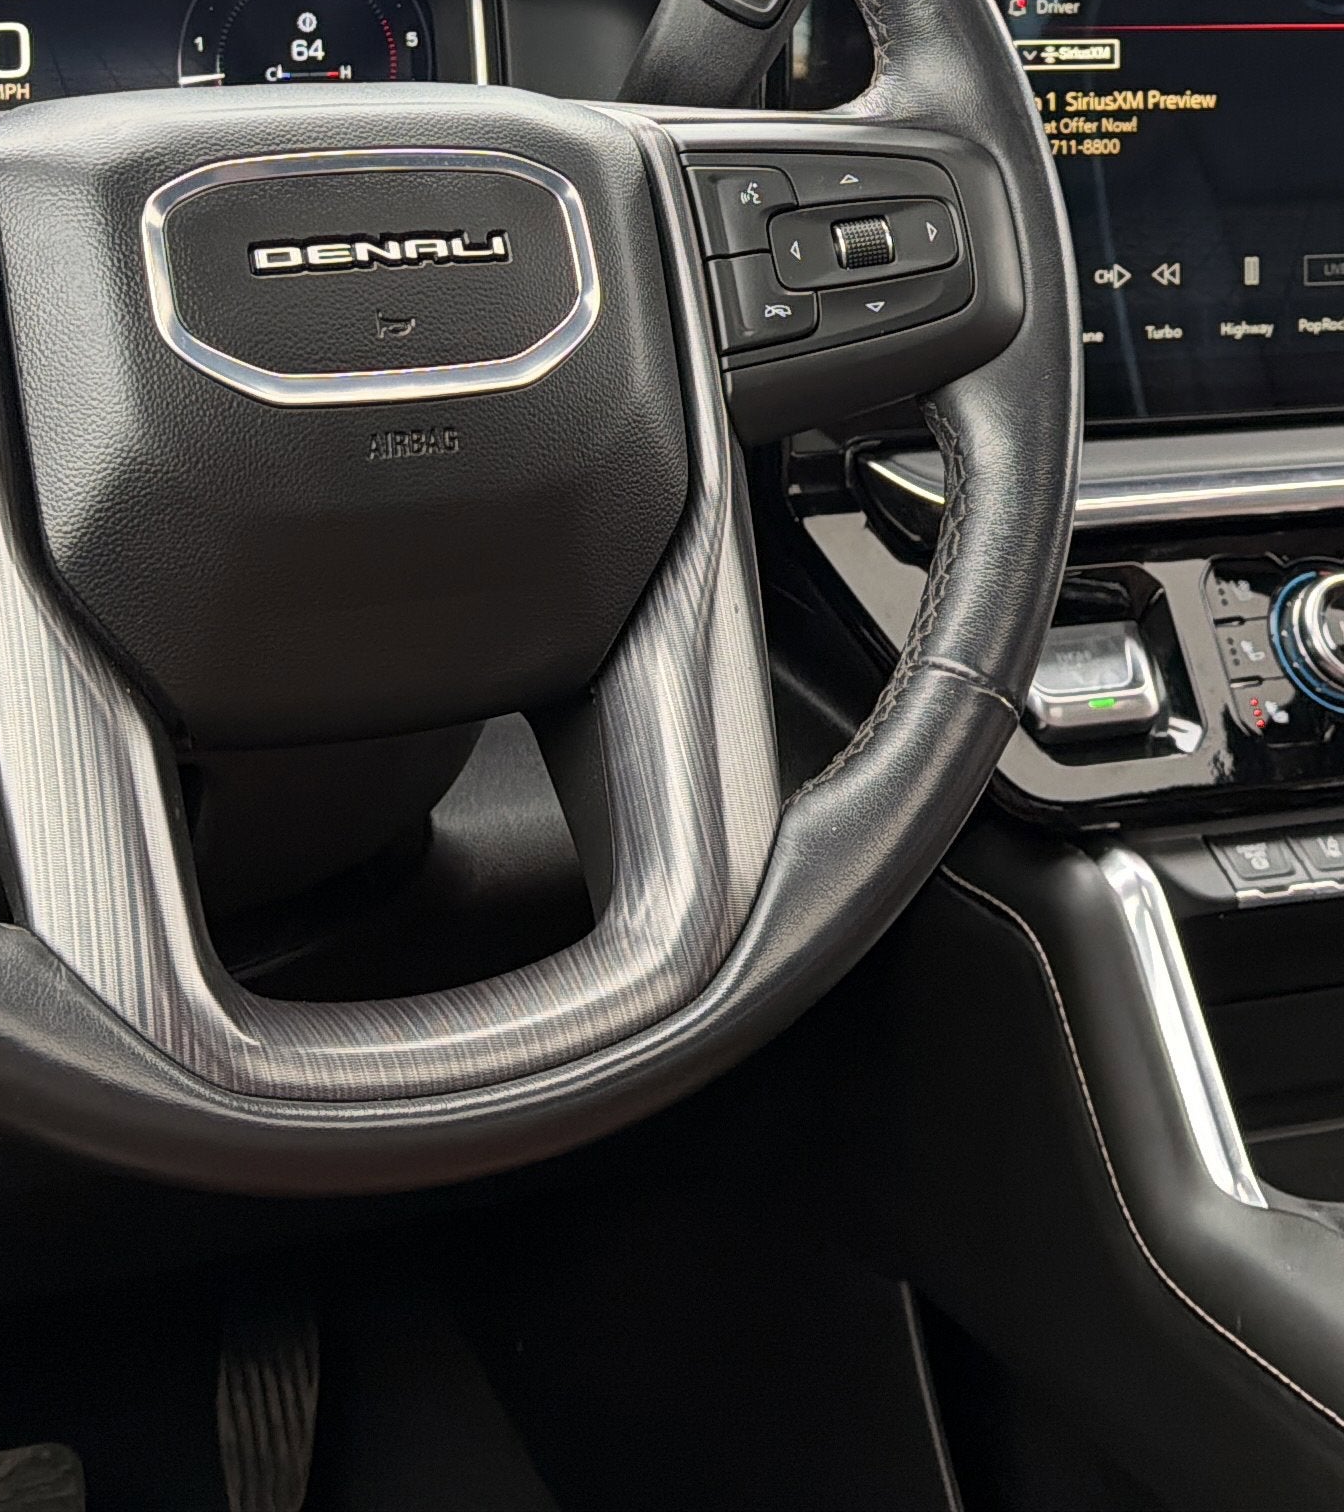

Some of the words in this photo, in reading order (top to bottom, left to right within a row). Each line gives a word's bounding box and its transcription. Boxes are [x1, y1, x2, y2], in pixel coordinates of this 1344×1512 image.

[193, 36, 204, 52] 1
[405, 31, 419, 48] 5
[290, 39, 325, 61] 64
[339, 65, 352, 80] H
[1045, 91, 1056, 112] 1
[1065, 90, 1144, 112] SiriusXM
[1148, 89, 1217, 110] Preview
[1060, 117, 1098, 134] Offer
[1101, 116, 1138, 134] Now!
[252, 234, 508, 272] DENALI
[1094, 269, 1113, 285] CH
[1145, 324, 1183, 340] Turbo
[1220, 320, 1274, 340] Highway
[367, 427, 460, 462] AIRBAG
